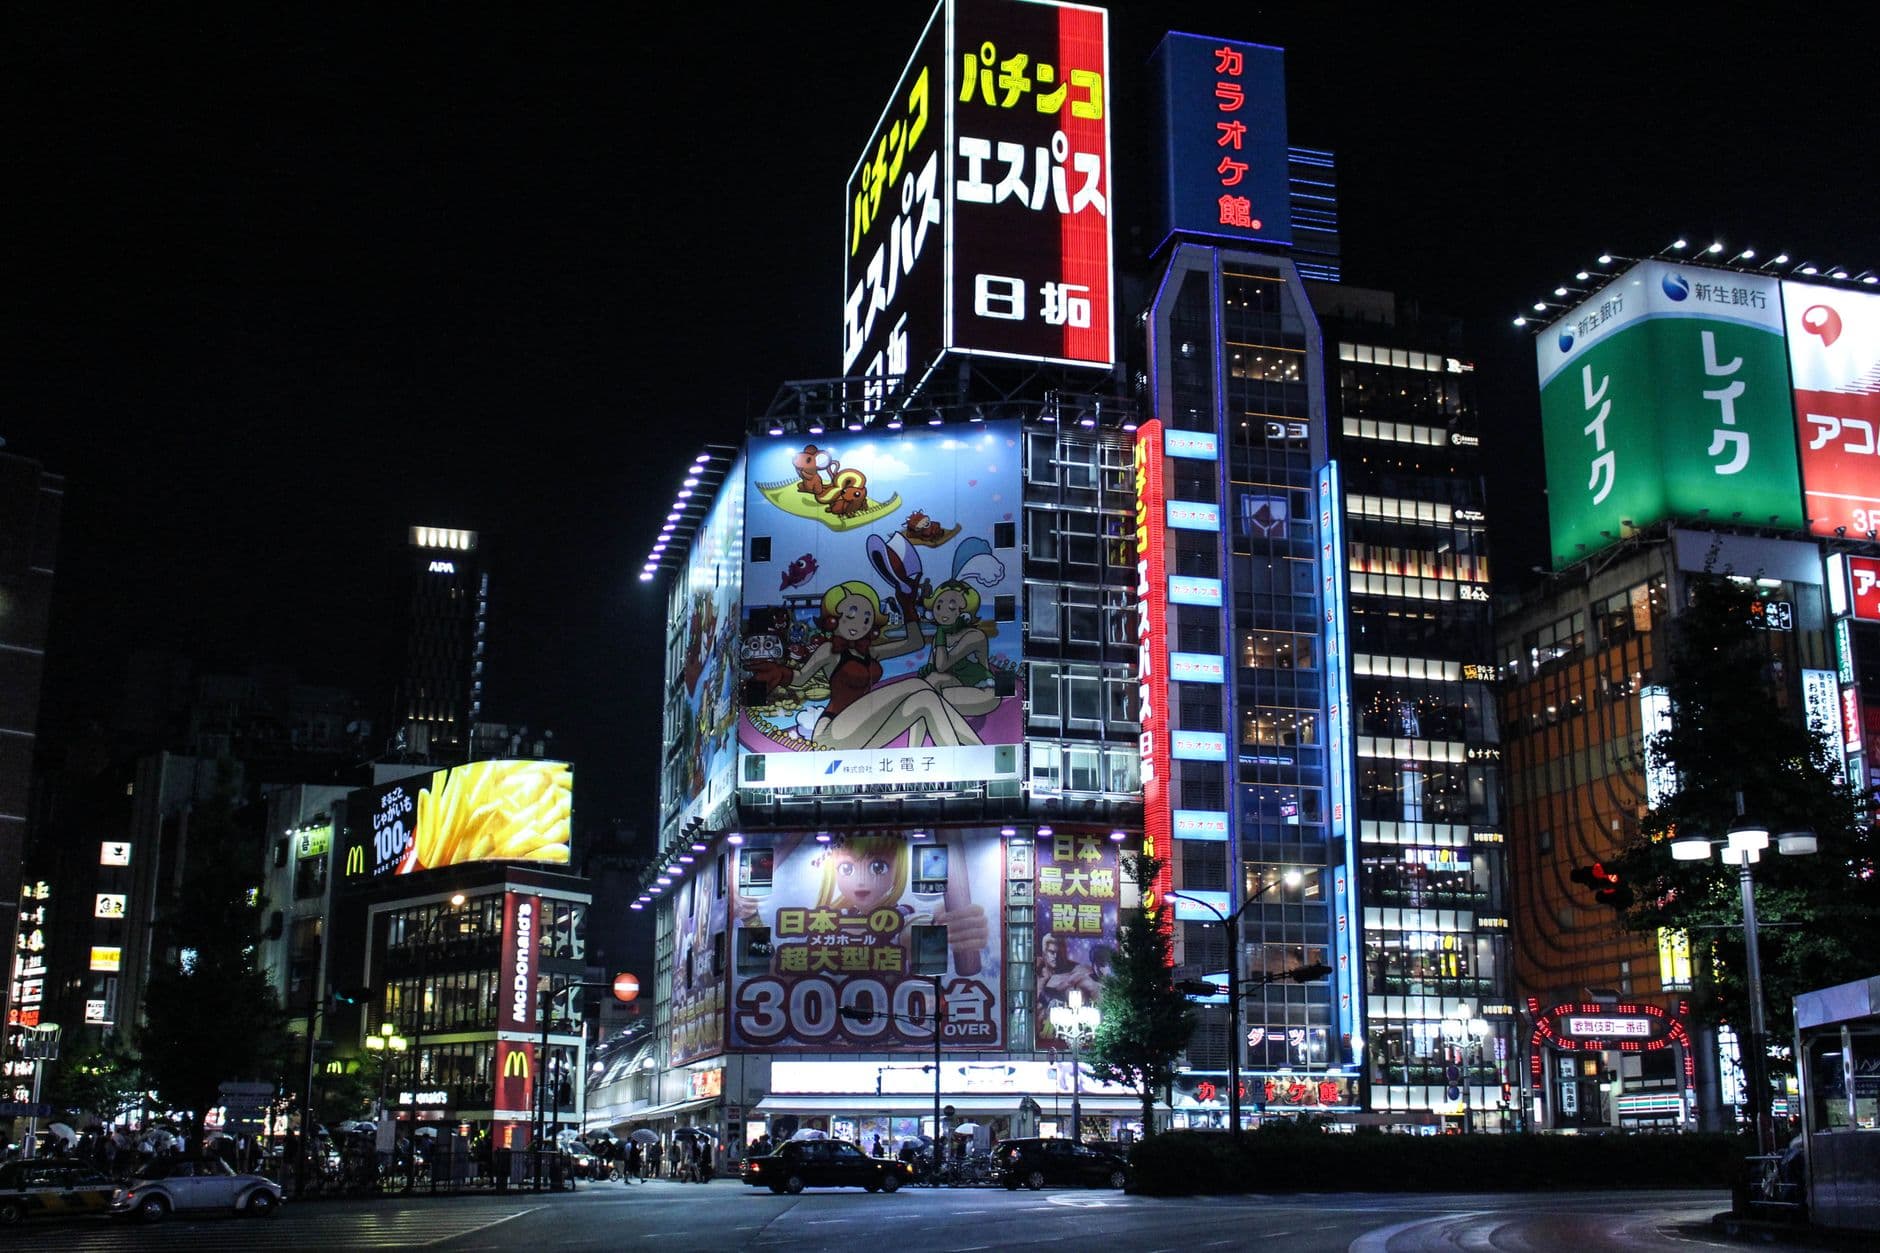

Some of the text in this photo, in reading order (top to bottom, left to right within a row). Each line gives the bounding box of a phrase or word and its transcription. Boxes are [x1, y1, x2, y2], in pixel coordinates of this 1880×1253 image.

[959, 41, 1103, 120] パチンコ
[851, 65, 929, 257] パチンコ
[956, 130, 1106, 217] エスパス
[844, 150, 940, 376] エスパス
[975, 273, 1091, 328] 日拓
[1695, 282, 1768, 310] 新生銀行
[1577, 292, 1624, 339] 新生銀行
[1701, 330, 1750, 475] レイク
[1169, 439, 1215, 450] カラオケ館
[1582, 363, 1616, 506] レイク
[1807, 413, 1880, 456] アコ
[1135, 436, 1148, 553] パチンコ
[1171, 509, 1217, 521] カラオケ館
[428, 561, 455, 573] APA
[1173, 584, 1219, 597] カラオケ館
[1853, 569, 1880, 596] ア
[1137, 559, 1152, 723] エスパス
[1175, 662, 1221, 674] カラオケ館
[1177, 741, 1223, 752] カラオケ館
[842, 754, 936, 774] 株式会社 北電子
[381, 787, 404, 808] まるごと
[373, 796, 413, 830] じゃがいも
[1178, 820, 1225, 831] カラオケ館
[374, 820, 413, 865] 100%
[1053, 835, 1102, 863] 日本
[1038, 867, 1115, 899] 最大級
[780, 909, 899, 933] 日本一の
[1052, 904, 1102, 934] 設置
[810, 935, 876, 946] メガホール
[513, 903, 532, 1023] McDonald's
[780, 946, 902, 972] 超大型店
[944, 1023, 991, 1036] OVER
[1247, 1028, 1305, 1047] ダーツ
[1573, 1020, 1647, 1034] 歌舞伎町一番街
[399, 1091, 448, 1105] Mconald's
